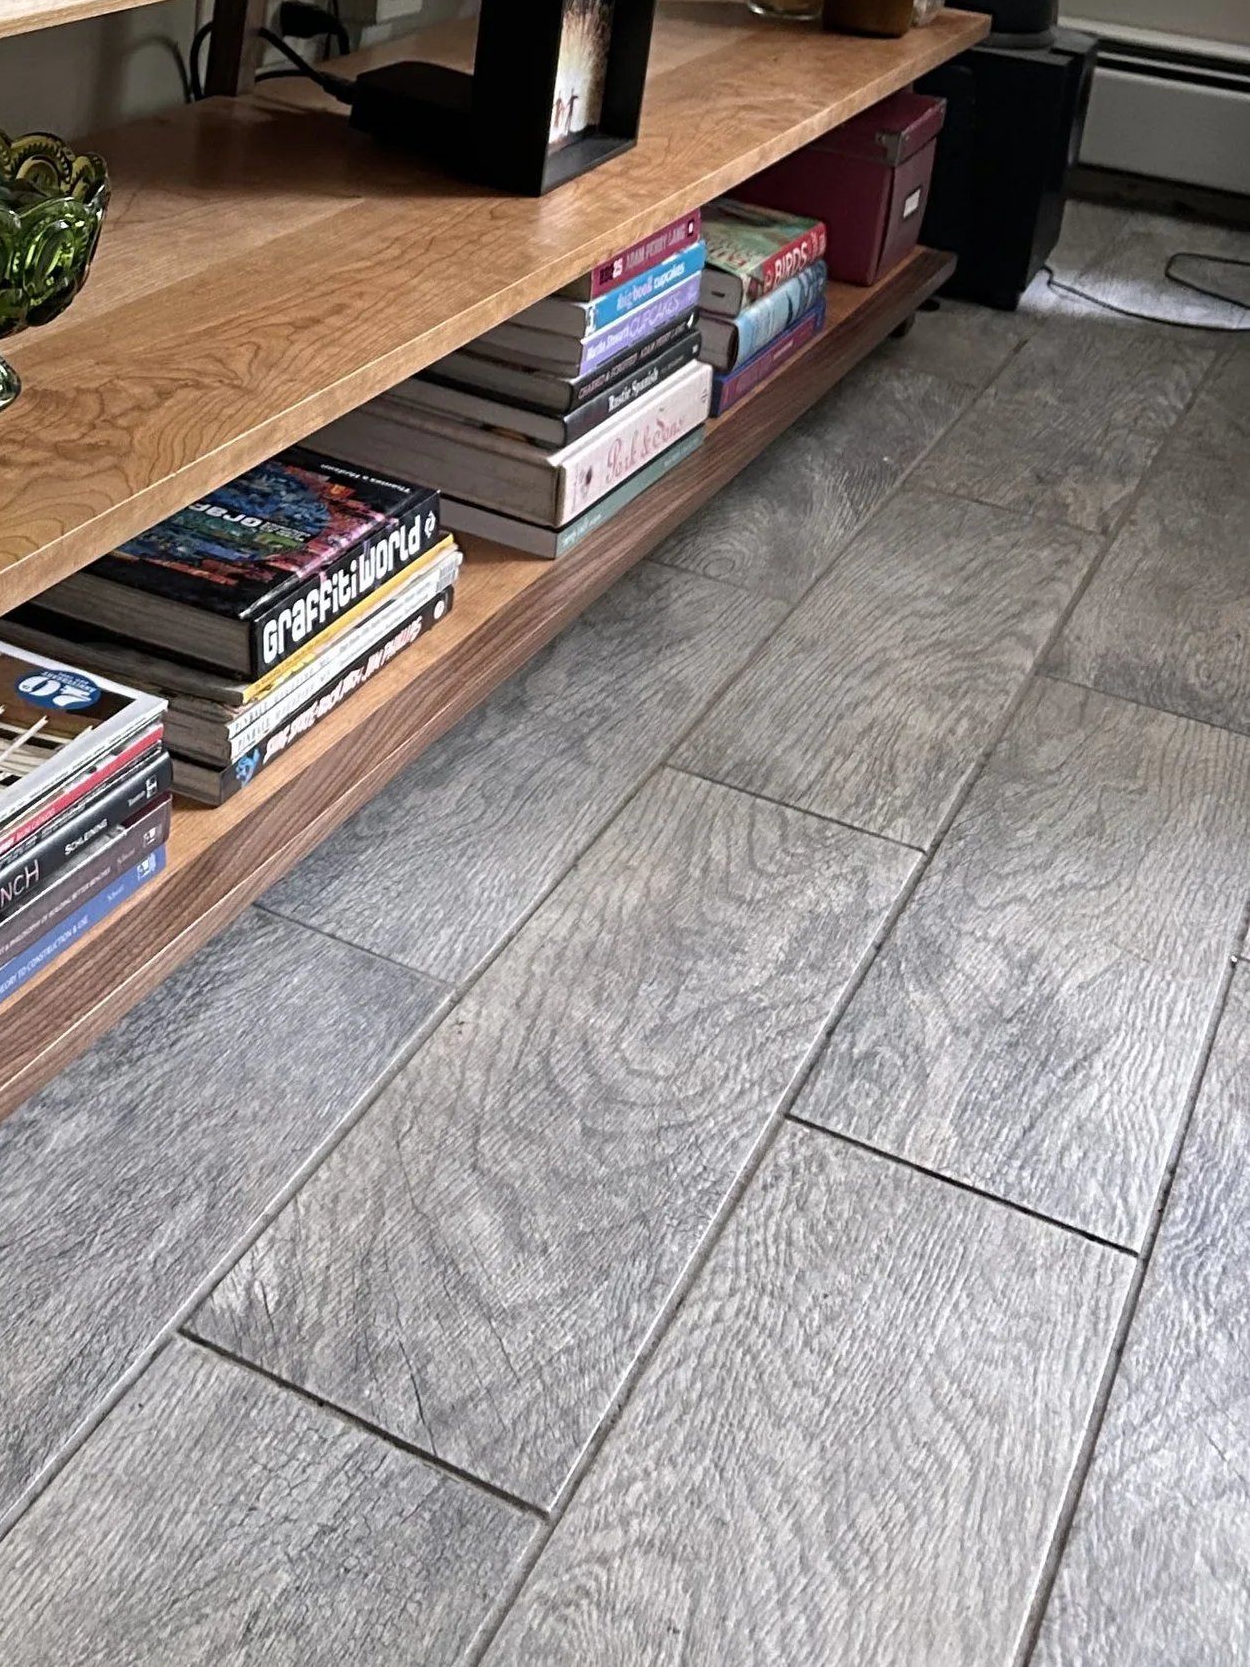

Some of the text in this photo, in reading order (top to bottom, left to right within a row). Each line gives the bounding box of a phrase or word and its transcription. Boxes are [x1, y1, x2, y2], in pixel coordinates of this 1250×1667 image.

[653, 262, 685, 289] cupcakes
[774, 241, 809, 285] BIRDS
[631, 367, 659, 397] Spanish
[27, 930, 72, 971] CONSTRUCTION
